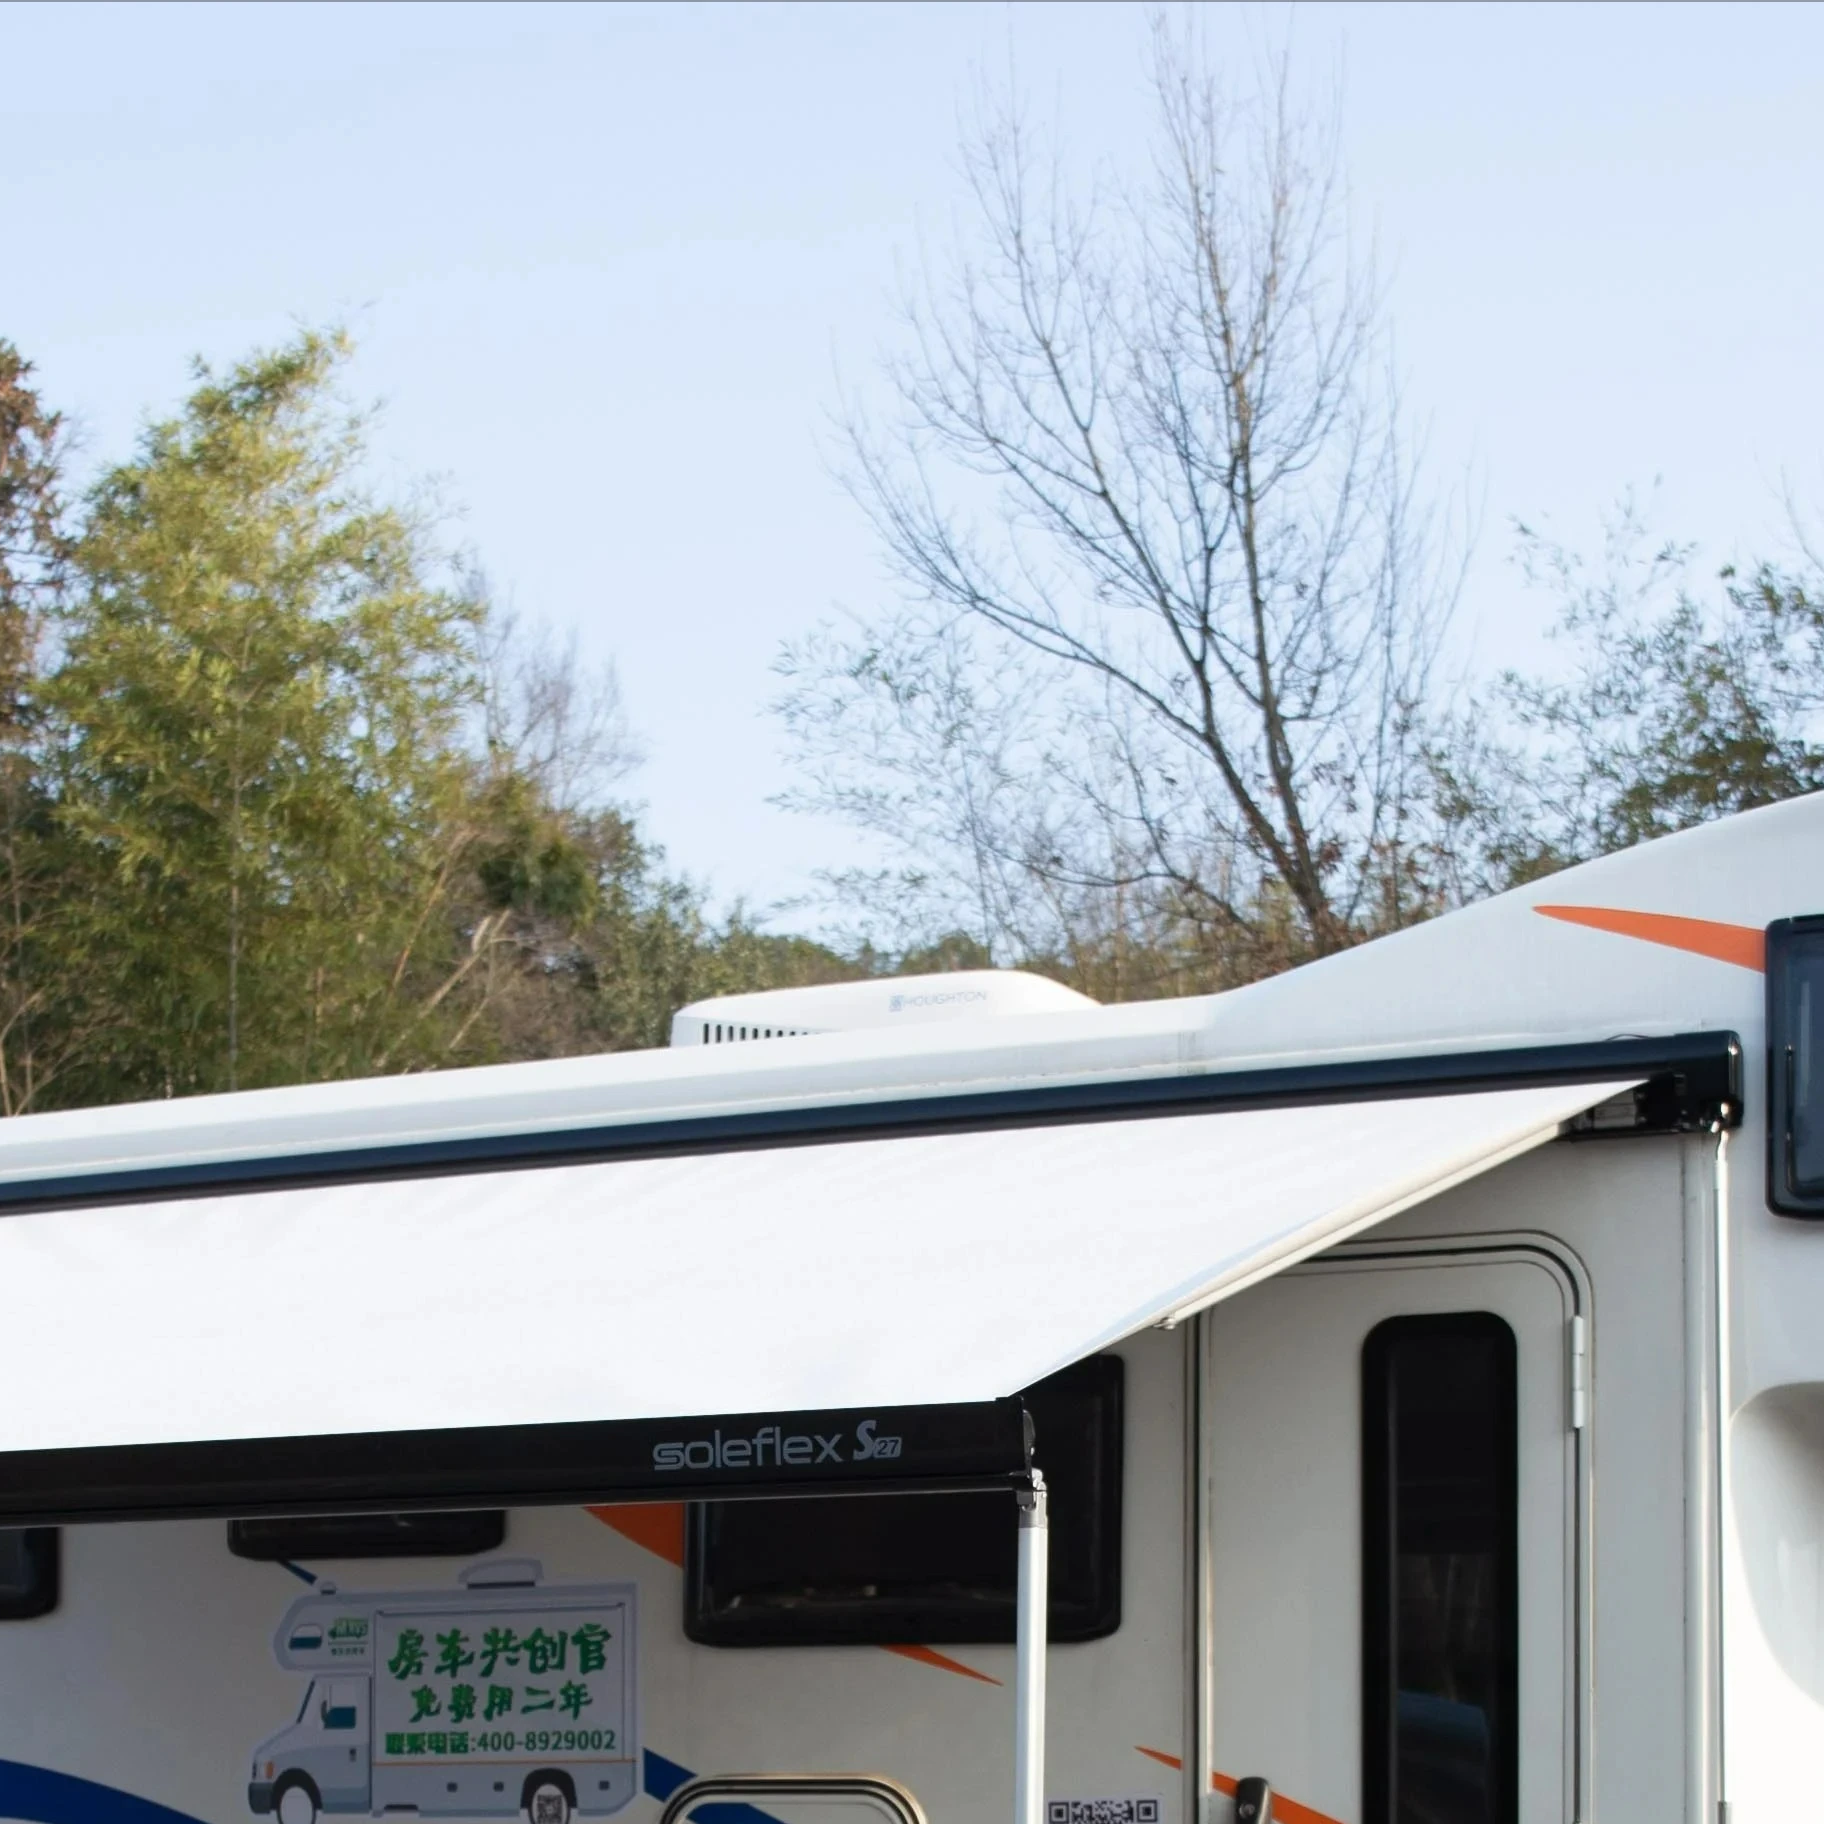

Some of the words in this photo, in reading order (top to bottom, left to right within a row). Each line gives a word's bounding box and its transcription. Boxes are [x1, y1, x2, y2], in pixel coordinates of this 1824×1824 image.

[652, 1426, 844, 1471] soleflex
[387, 1622, 612, 1680] 房车共创官
[408, 1680, 593, 1724] 免费用二年
